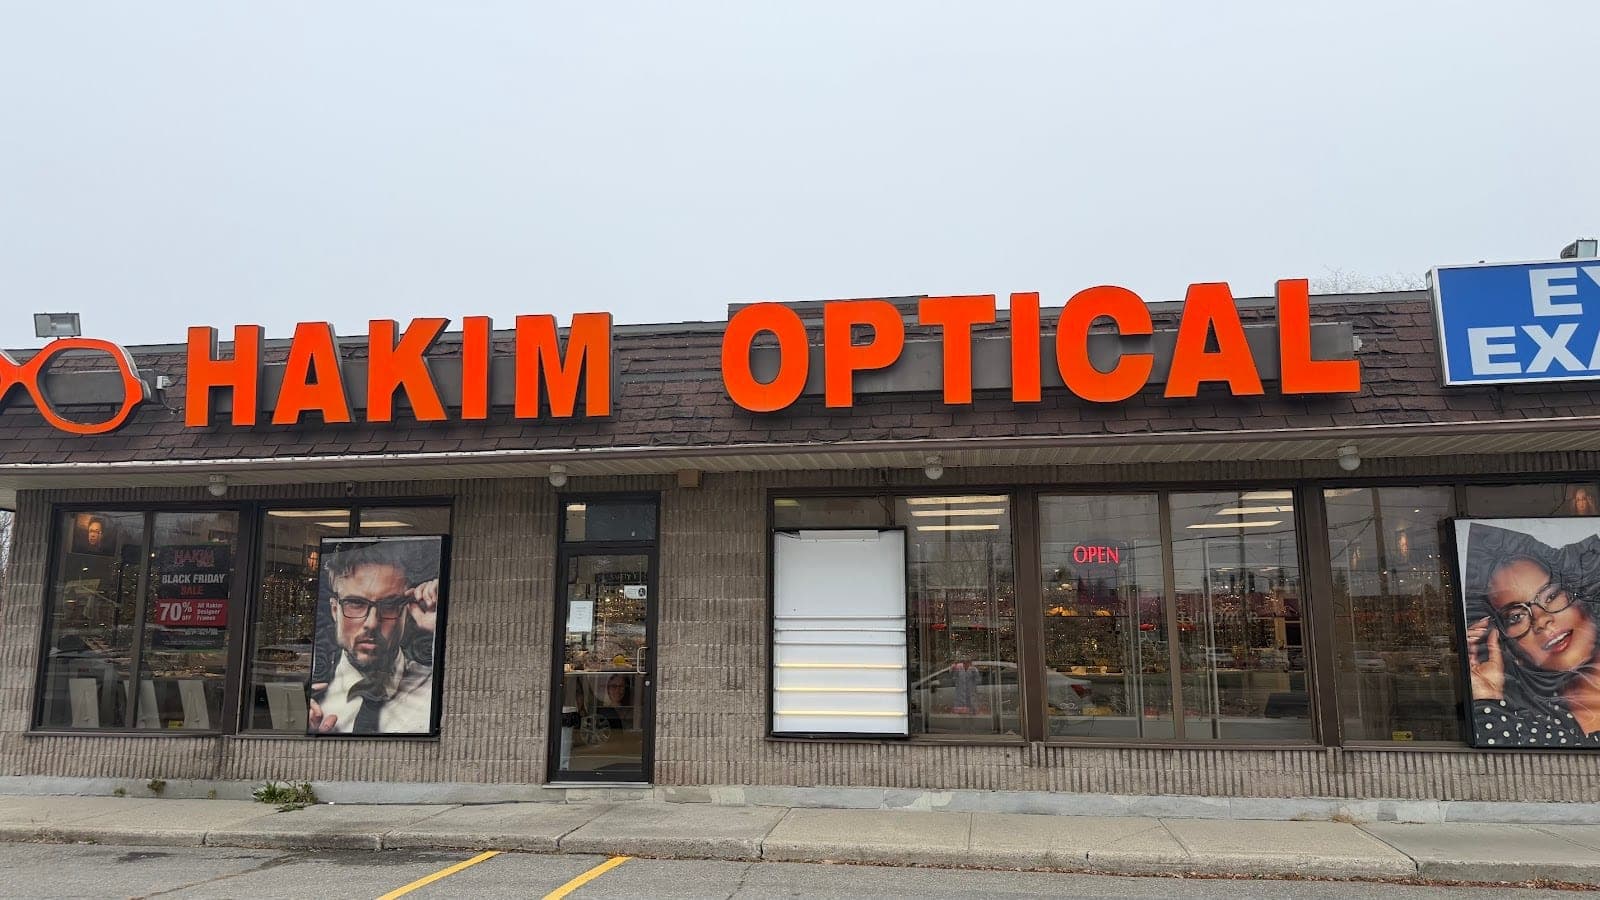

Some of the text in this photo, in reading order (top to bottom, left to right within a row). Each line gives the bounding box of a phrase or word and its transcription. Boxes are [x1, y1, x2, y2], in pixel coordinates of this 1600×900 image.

[185, 278, 1361, 427] HAKIM OPTICAL
[1467, 323, 1600, 376] EX
[1073, 545, 1120, 564] OPEN
[162, 574, 226, 584] BLACK FRIDAY
[180, 585, 205, 595] SALE
